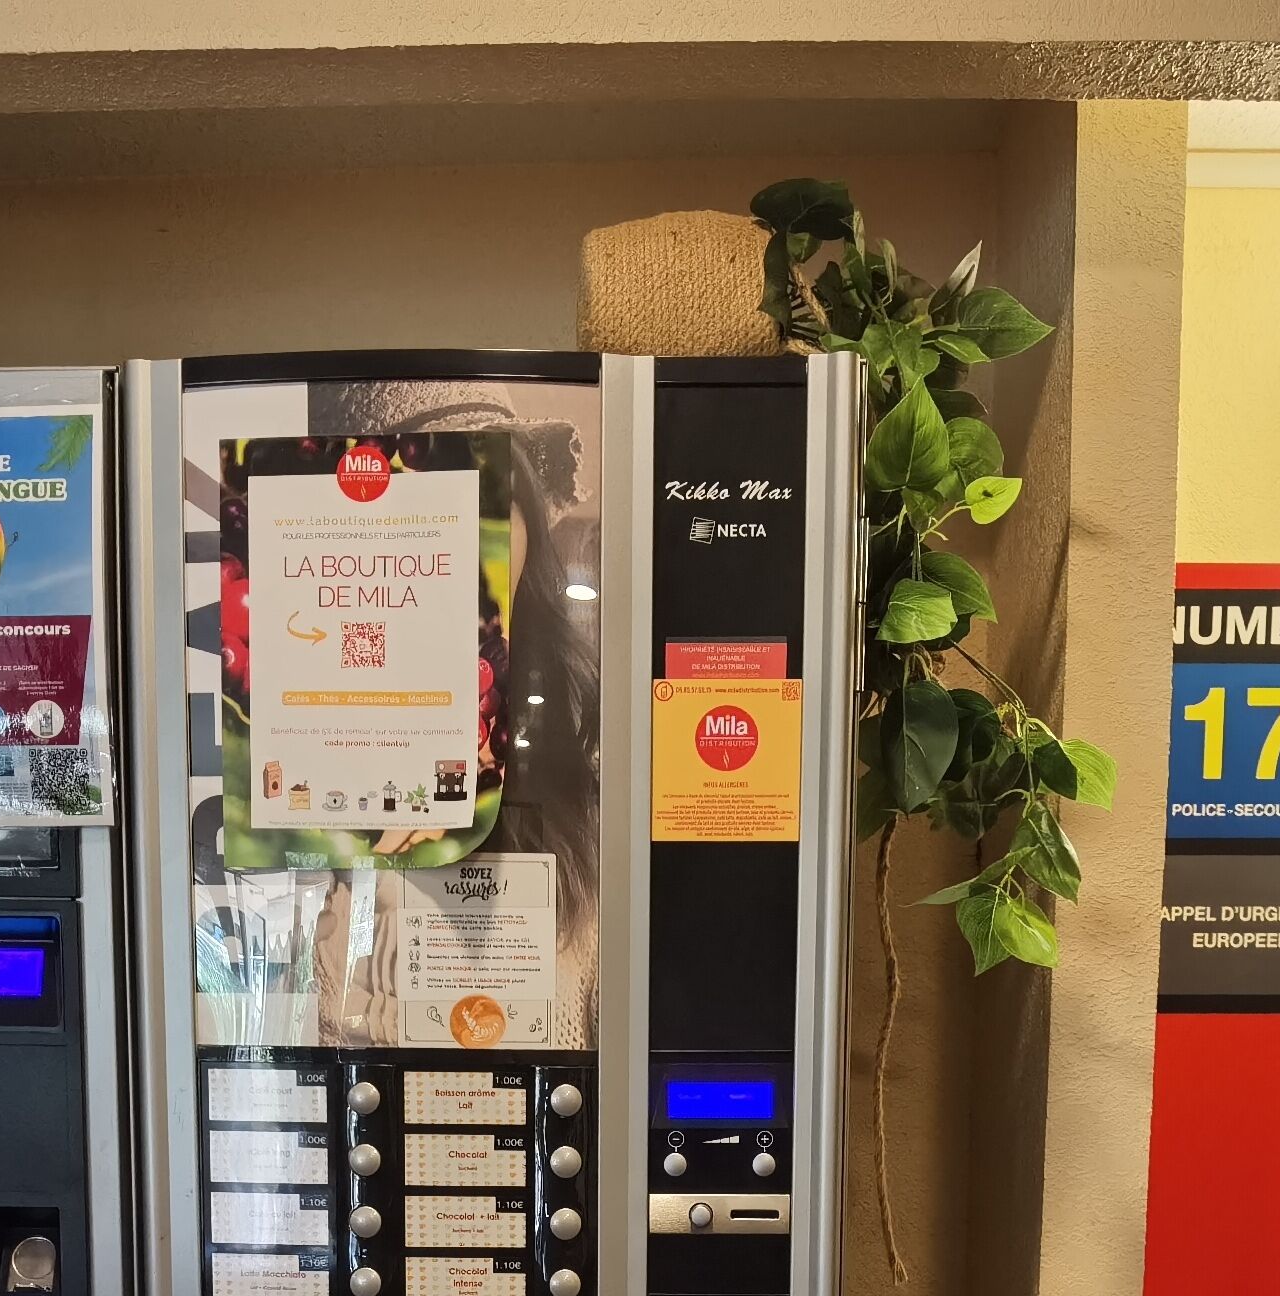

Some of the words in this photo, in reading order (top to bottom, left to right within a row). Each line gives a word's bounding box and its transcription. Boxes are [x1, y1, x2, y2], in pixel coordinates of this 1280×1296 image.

[346, 454, 382, 472] Mila
[340, 474, 389, 482] DISTRIBUTION
[665, 481, 731, 501] Kikko
[739, 480, 792, 501] Max
[274, 513, 459, 528] www.laboutiquedemila.com
[717, 524, 767, 538] NECTA
[285, 556, 315, 578] LA
[322, 554, 451, 578] BOUTIQUE
[319, 586, 351, 607] DE
[358, 586, 418, 607] MILA
[347, 694, 400, 704] Accessoires
[408, 695, 449, 704] Machines
[705, 715, 748, 736] Mila
[460, 867, 493, 879] SOYEZ
[444, 880, 501, 902] rassurés
[1160, 906, 1217, 922] APPEL
[298, 1074, 325, 1083] 1.00€
[495, 1076, 523, 1085] 1.00€
[435, 1089, 466, 1098] Boisson
[468, 1088, 496, 1098] arôme
[458, 1101, 473, 1110] Lait
[496, 1138, 524, 1147] 1.00€
[448, 1150, 487, 1159] Chocolat
[496, 1201, 524, 1209] 1.10€
[436, 1212, 475, 1221] Chocolat
[487, 1212, 500, 1221] lait
[494, 1261, 522, 1270] 1.10€
[262, 1270, 307, 1279] Macchiato
[449, 1267, 488, 1276] Chocolat
[453, 1279, 483, 1288] Intense
